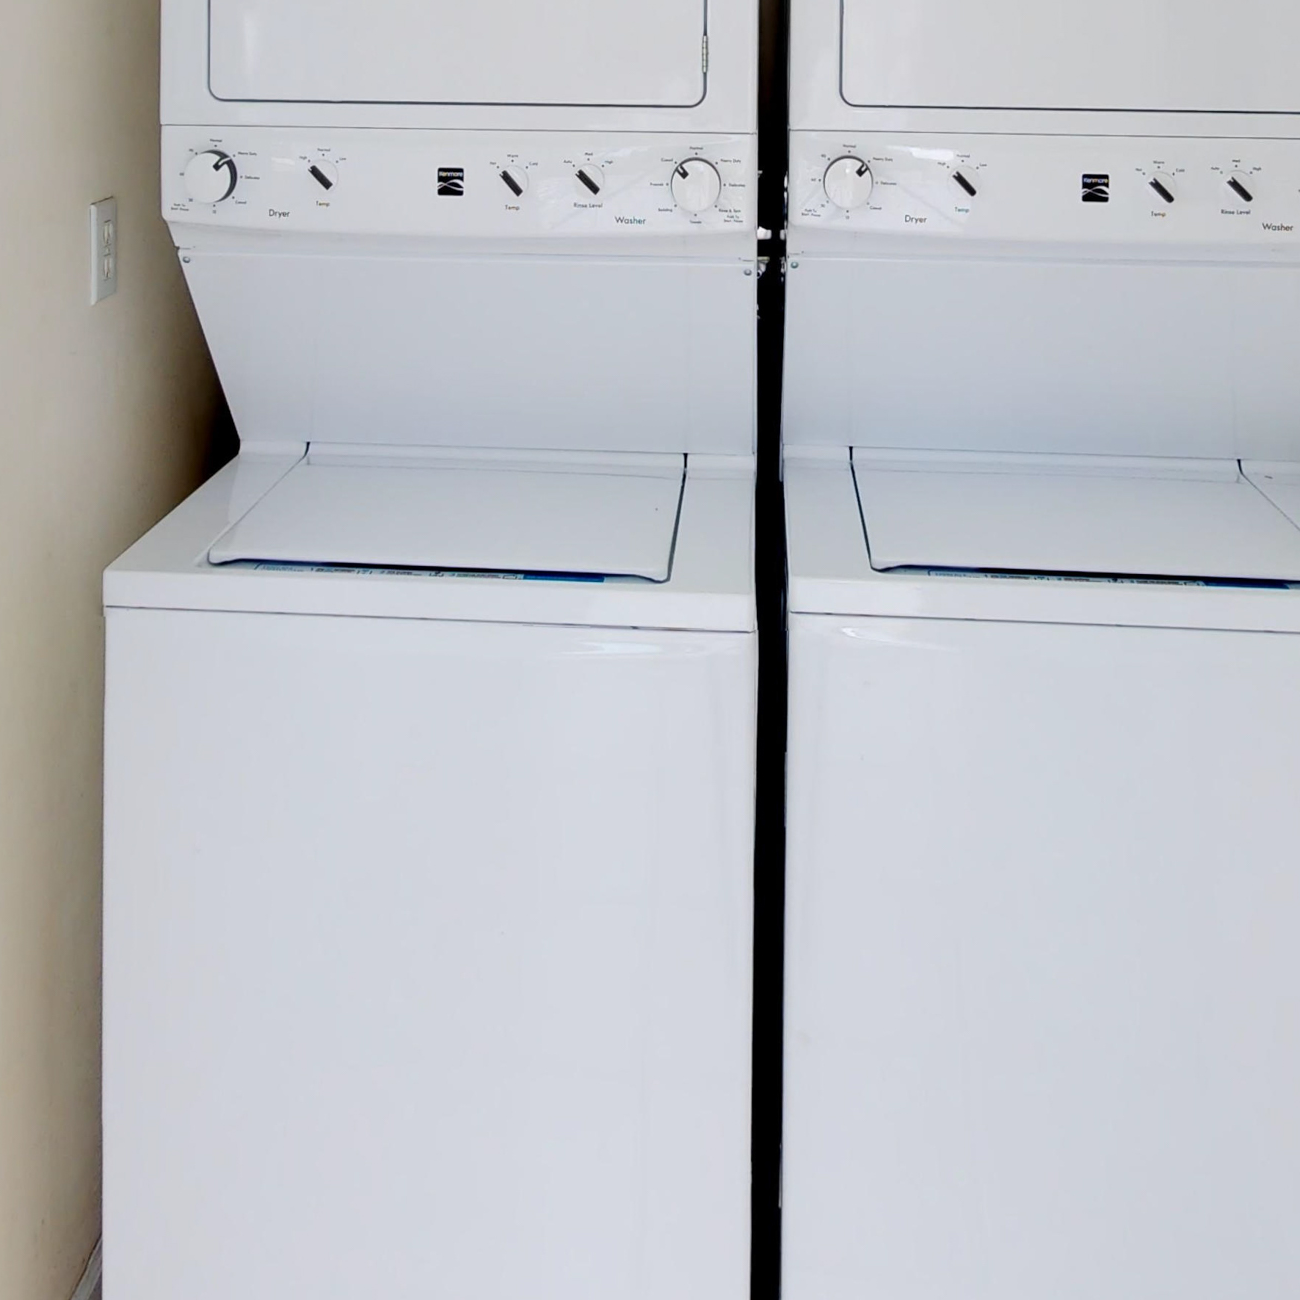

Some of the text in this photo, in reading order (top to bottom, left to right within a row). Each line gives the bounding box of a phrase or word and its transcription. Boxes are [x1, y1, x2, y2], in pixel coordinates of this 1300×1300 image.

[268, 208, 290, 218] Dryer
[614, 216, 646, 224] Washer
[904, 214, 927, 224] Dryer
[1262, 222, 1294, 231] Washer
